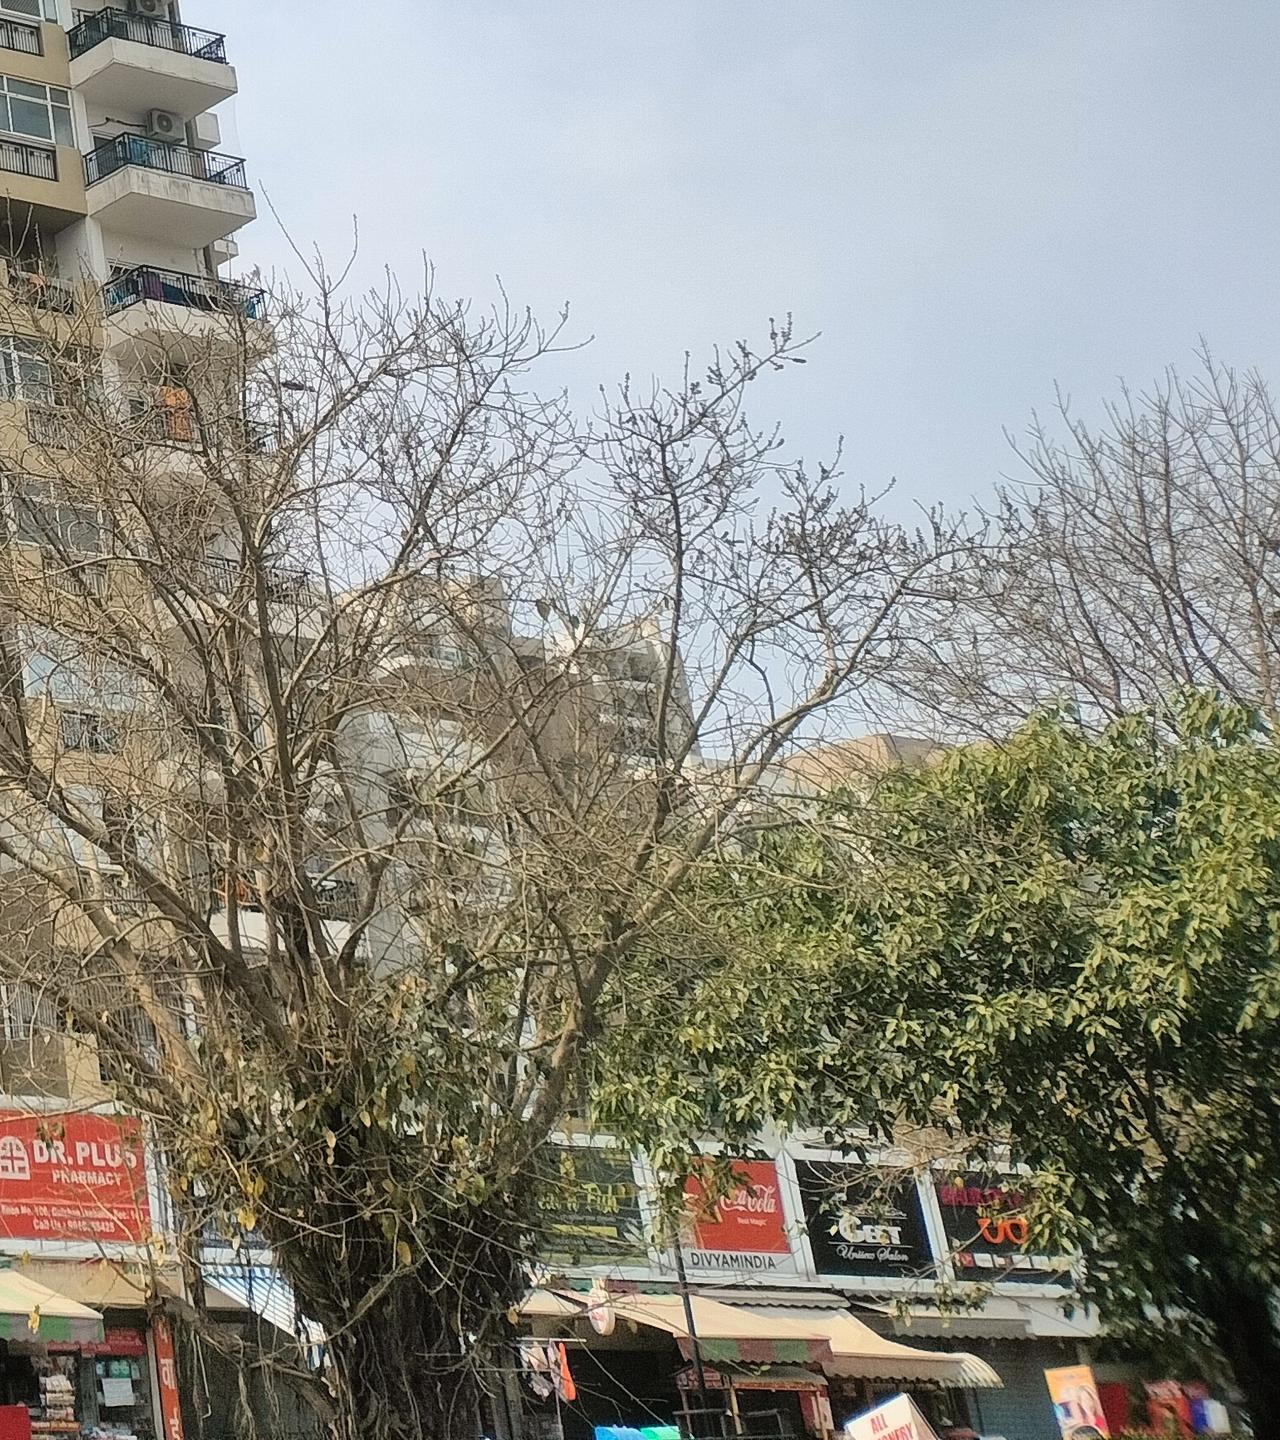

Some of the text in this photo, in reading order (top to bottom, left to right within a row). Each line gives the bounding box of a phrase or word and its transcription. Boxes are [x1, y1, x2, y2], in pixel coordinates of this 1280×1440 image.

[32, 1139, 73, 1165] DR.
[52, 1169, 123, 1186] PHARMACY
[690, 1252, 777, 1270] DIVYAMINDIA
[870, 1413, 889, 1435] ALL
